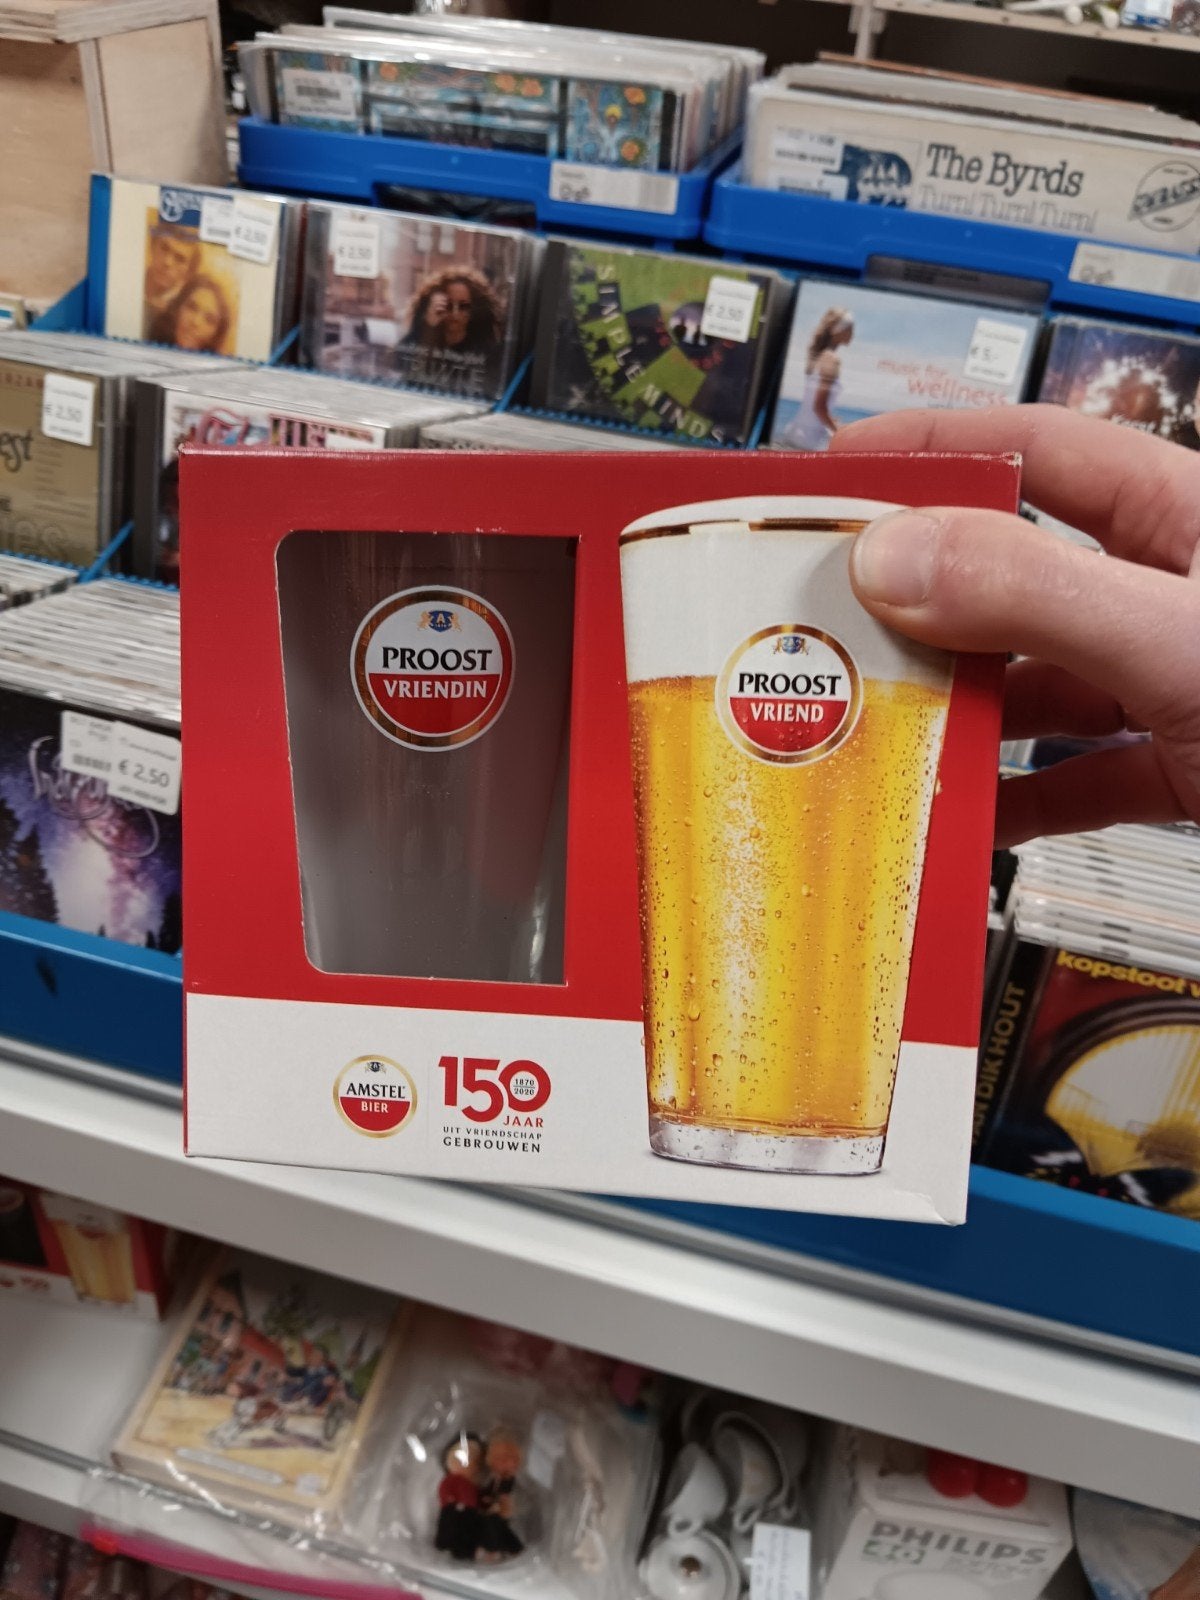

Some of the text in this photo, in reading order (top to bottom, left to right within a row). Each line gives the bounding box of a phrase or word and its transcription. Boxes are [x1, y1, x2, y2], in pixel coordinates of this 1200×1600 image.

[926, 142, 983, 183] The
[986, 151, 1085, 198] Byrds
[908, 378, 1008, 406] wellness
[382, 646, 493, 672] PROOST
[383, 679, 488, 699] VRIENDIN
[738, 672, 842, 696] PROOST
[750, 702, 825, 723] VRIEND
[990, 981, 1026, 1057] HOUT
[346, 1082, 405, 1099] AMSTEL
[438, 1056, 552, 1123] 150
[513, 1086, 535, 1096] 2020
[514, 1078, 535, 1087] 1870
[360, 1101, 389, 1114] BIER
[502, 1115, 544, 1128] JAAR
[443, 1126, 543, 1141] UIT VRIENDSCHAP
[443, 1137, 541, 1153] GEBROUWEN
[871, 1520, 1048, 1565] PHILIPS
